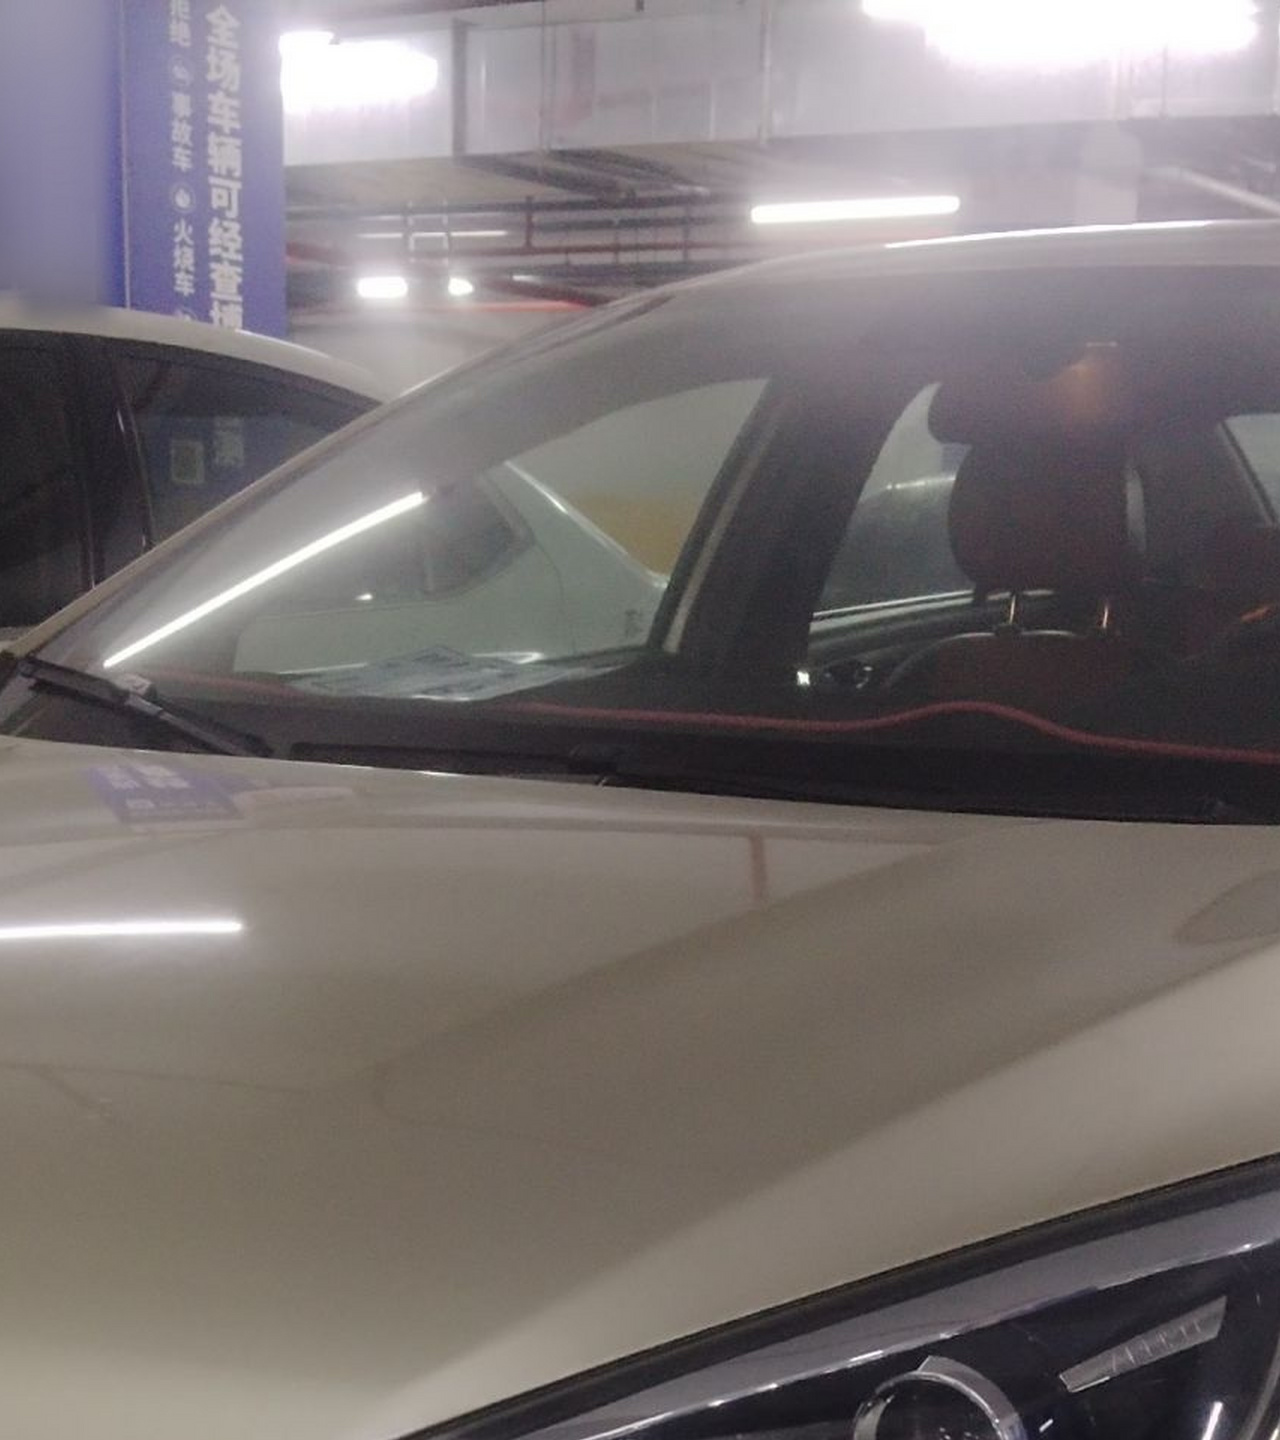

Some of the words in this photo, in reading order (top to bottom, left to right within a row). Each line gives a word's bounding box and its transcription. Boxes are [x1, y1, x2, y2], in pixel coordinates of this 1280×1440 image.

[171, 91, 193, 172] 事故车
[173, 219, 195, 297] 火烧车
